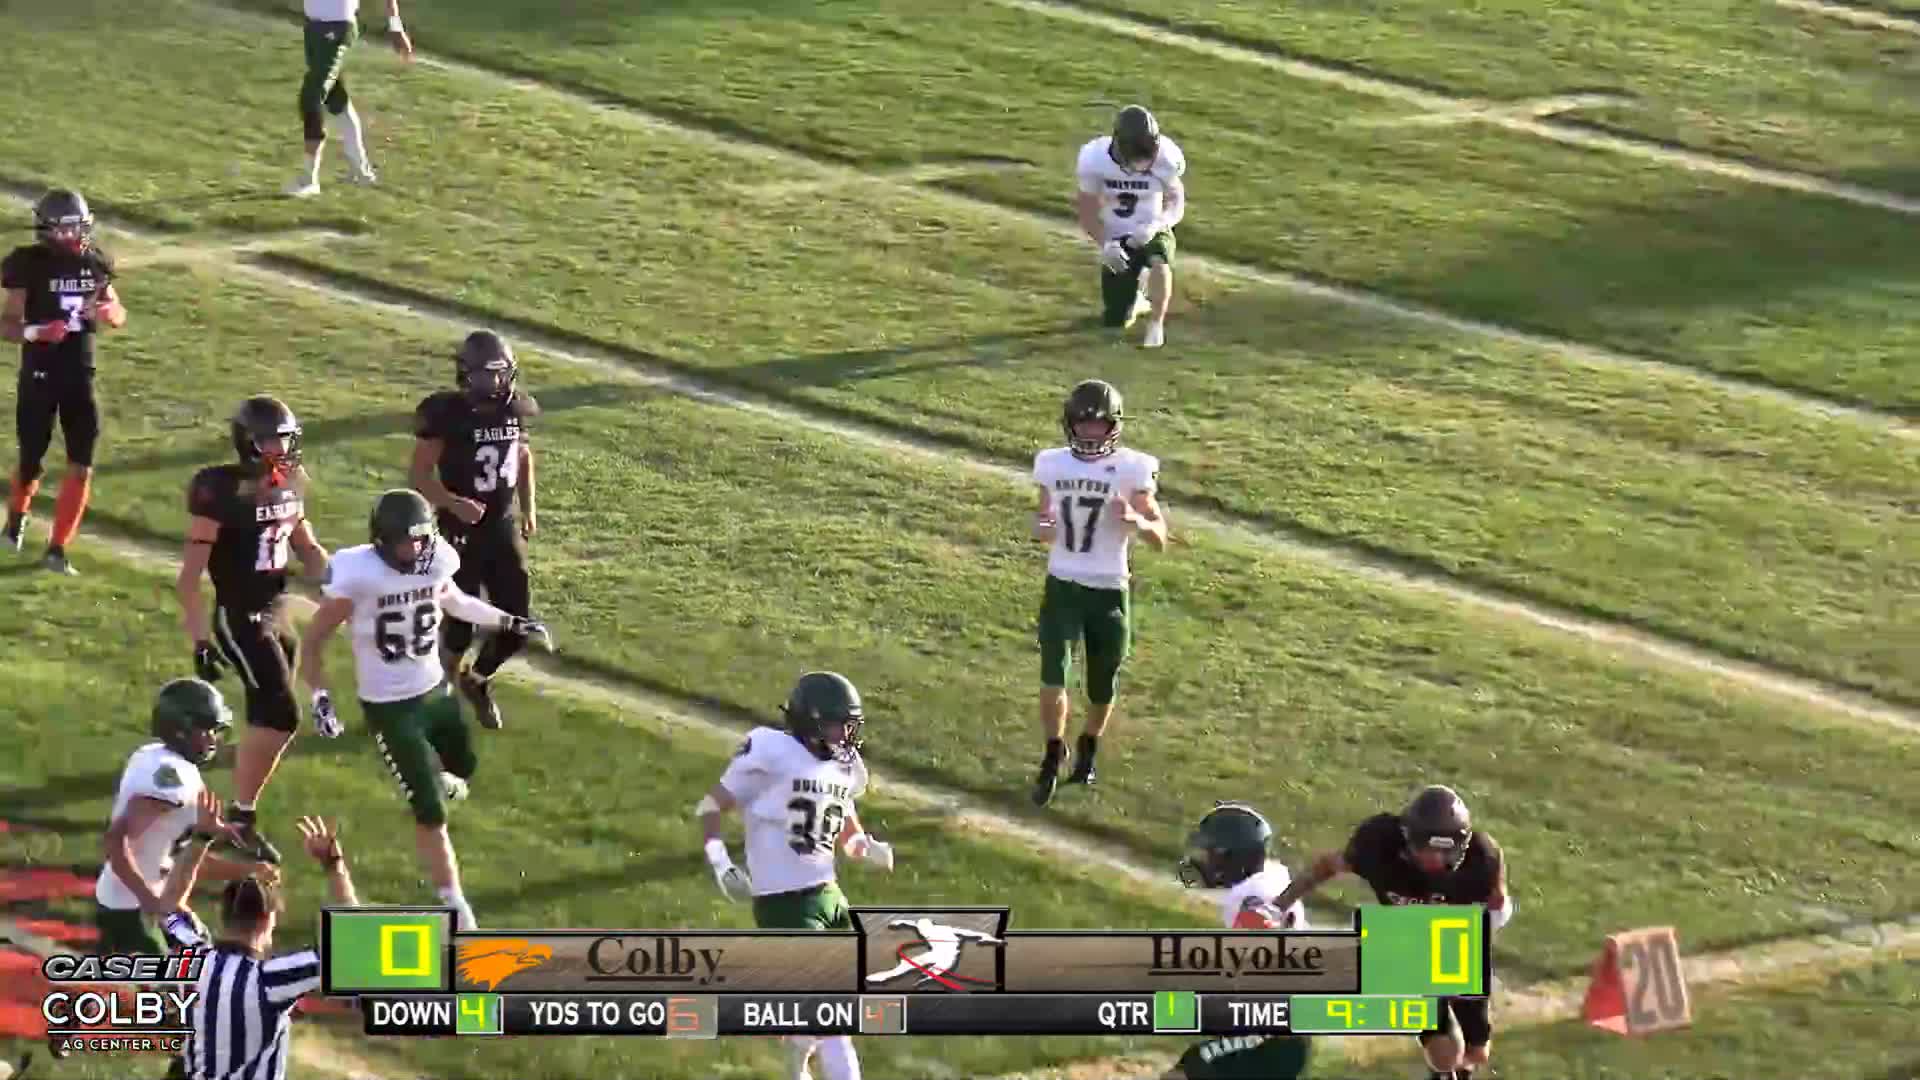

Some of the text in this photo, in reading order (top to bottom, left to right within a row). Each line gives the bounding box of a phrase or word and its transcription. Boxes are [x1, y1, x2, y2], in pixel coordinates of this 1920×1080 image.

[1114, 192, 1138, 218] 3
[474, 426, 520, 442] EAGLES
[474, 441, 519, 492] 34
[1061, 496, 1105, 553] 17
[1621, 938, 1686, 1025] 20
